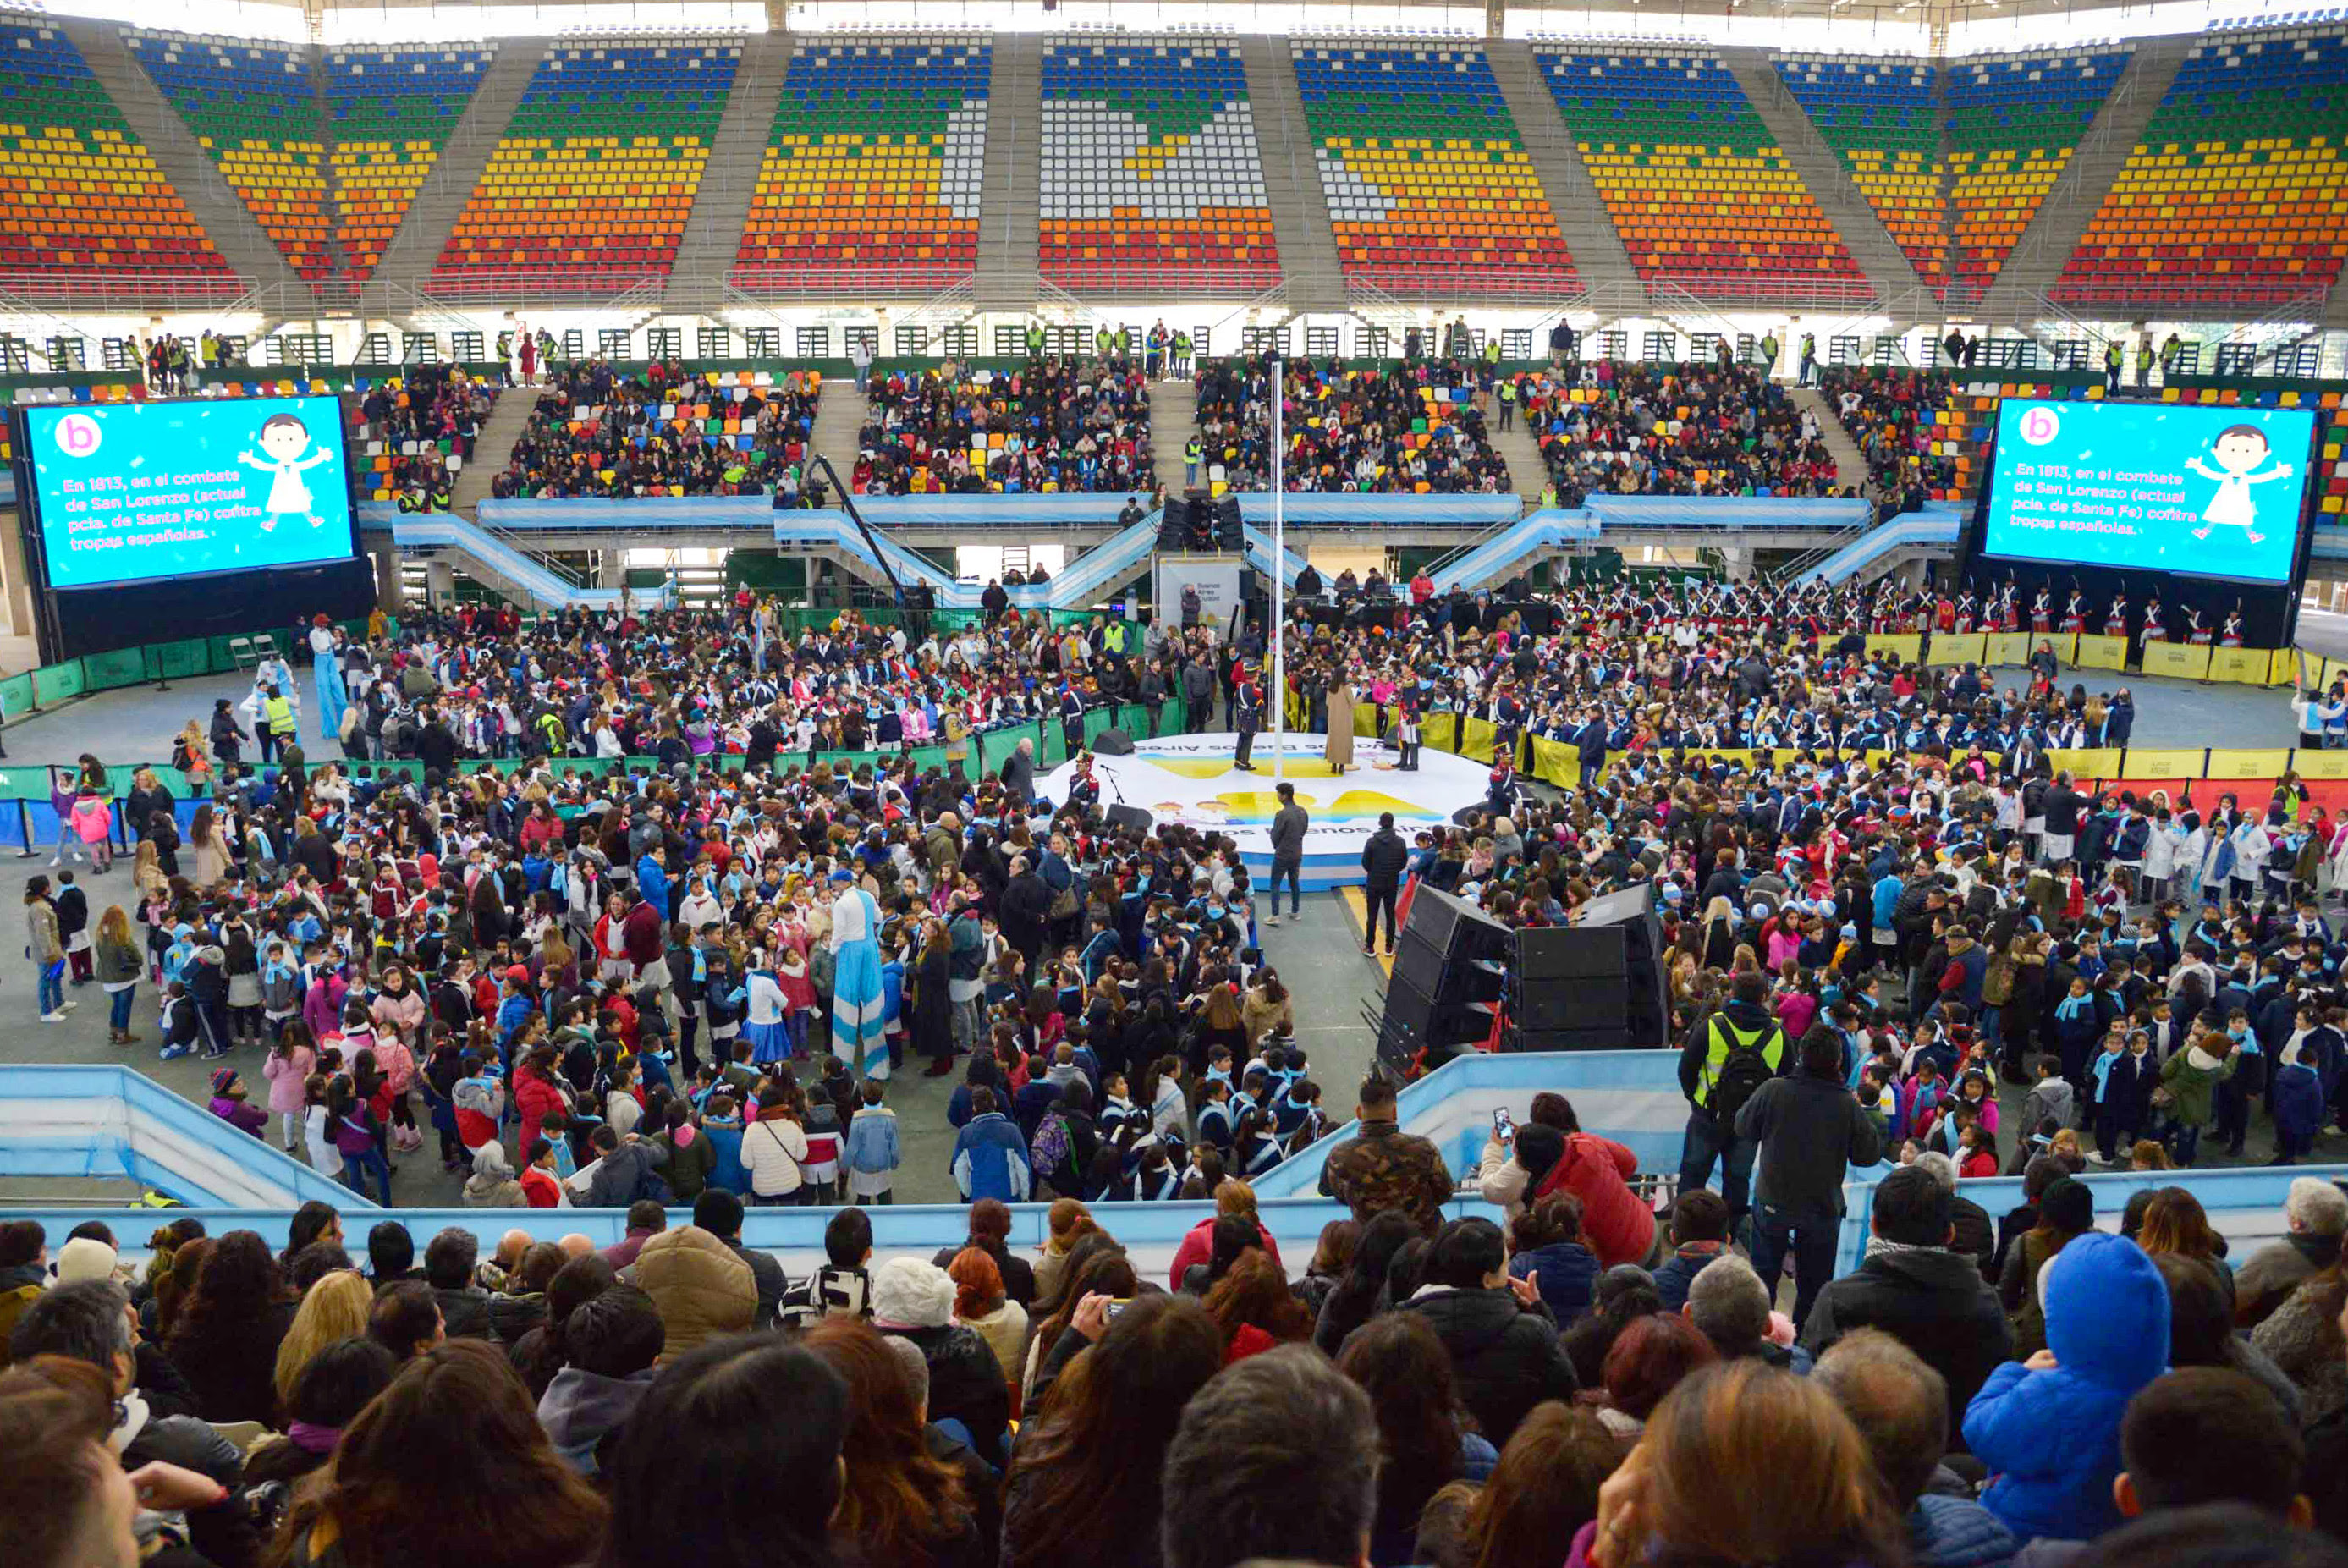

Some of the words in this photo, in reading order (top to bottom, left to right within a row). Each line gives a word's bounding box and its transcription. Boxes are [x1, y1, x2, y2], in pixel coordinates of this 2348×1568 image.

[66, 419, 93, 449] b
[2029, 410, 2052, 438] b
[63, 479, 85, 492] En
[89, 476, 128, 491] 1813,
[131, 476, 151, 488] en
[155, 473, 168, 486] el
[173, 470, 239, 485] combate
[2016, 463, 2034, 476] En
[2037, 465, 2071, 480] 1813,
[2076, 469, 2093, 480] en
[2098, 468, 2111, 481] el
[2115, 471, 2183, 485] combate
[65, 498, 87, 512] de
[91, 497, 122, 510] San
[126, 492, 190, 508] Lorenzo
[194, 486, 245, 503] (actual
[2014, 481, 2032, 492] de
[2036, 482, 2063, 495] San
[2067, 484, 2127, 499] Lorenzo
[2131, 488, 2185, 503] (actual
[69, 517, 107, 534] pcia.
[111, 514, 132, 527] de
[136, 512, 181, 525] Santa
[184, 509, 210, 522] Fe)
[213, 506, 261, 520] contra
[2011, 498, 2046, 510] pcia.
[2049, 499, 2069, 513] de
[2072, 501, 2114, 515] Santa
[2118, 505, 2142, 519] Fe)
[2147, 509, 2197, 522] contra
[2010, 514, 2056, 530] tropas
[2059, 520, 2137, 535] españolas.
[71, 536, 124, 551] tropas
[127, 525, 208, 546] españolas.
